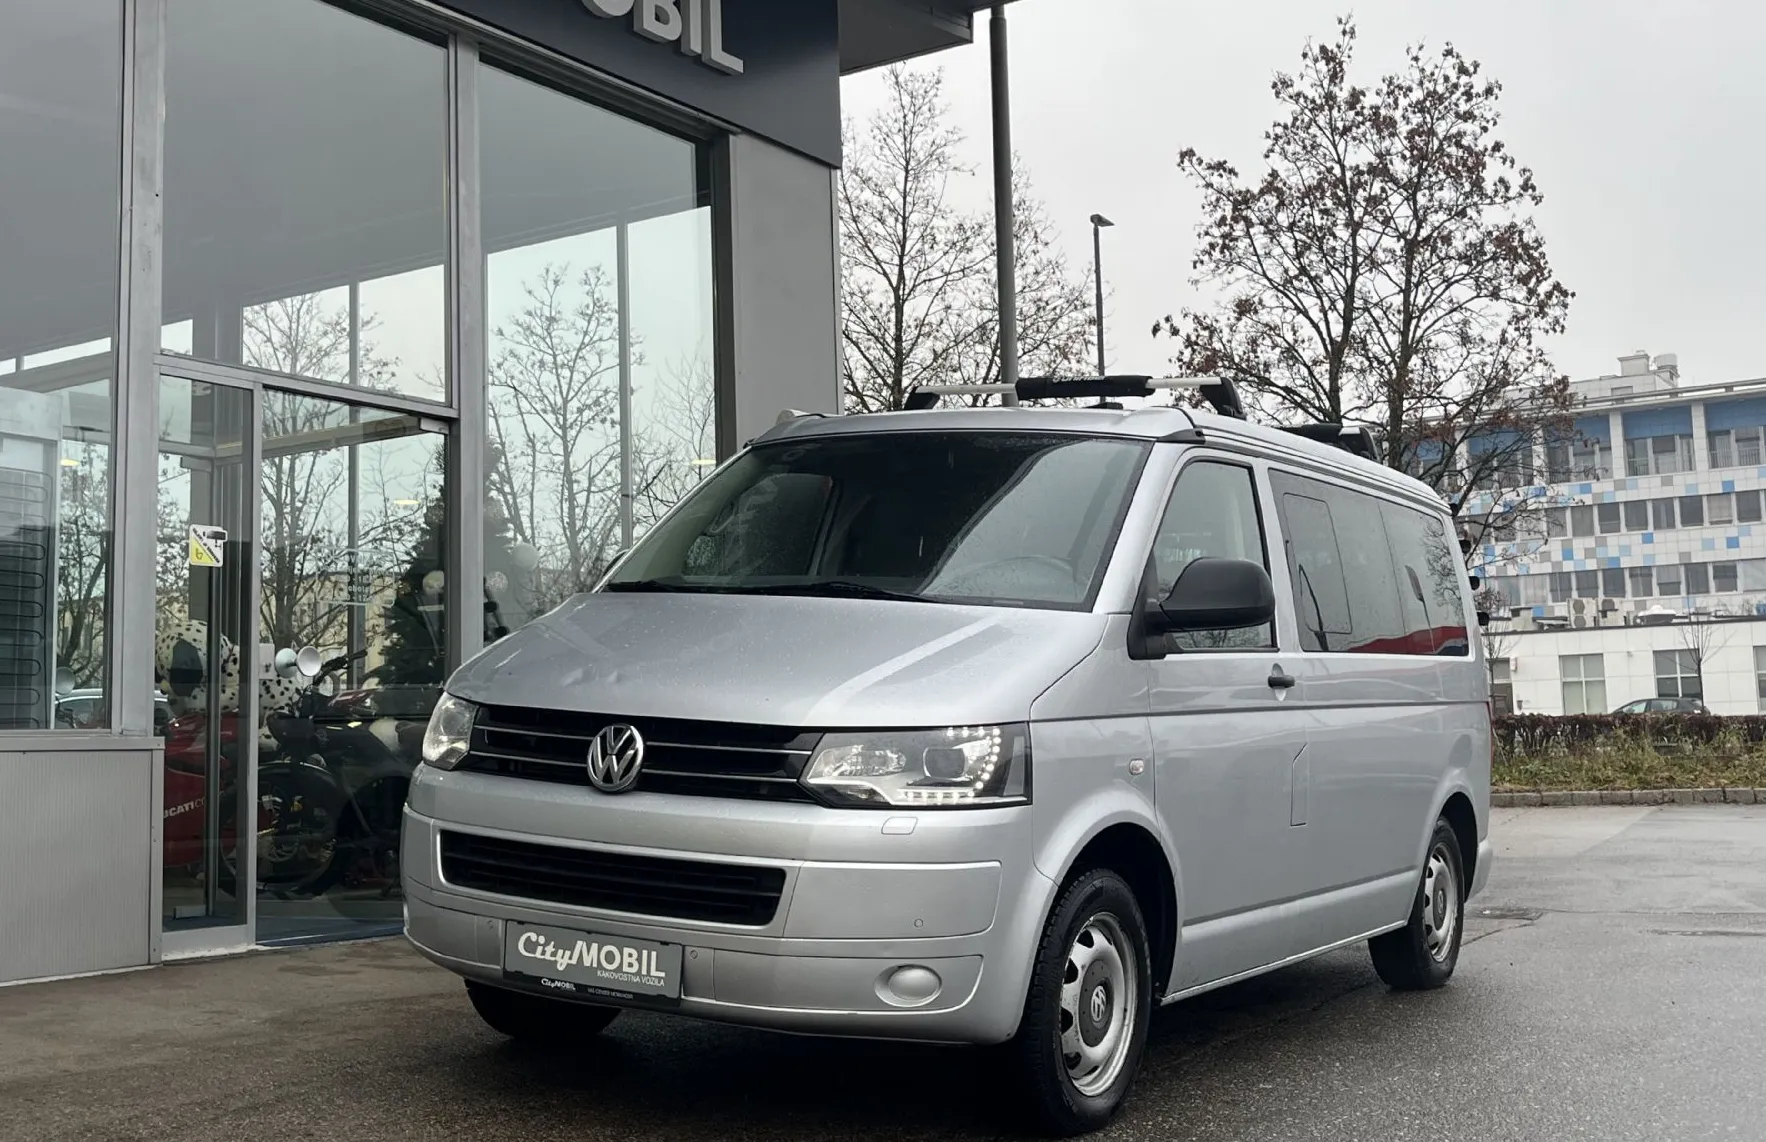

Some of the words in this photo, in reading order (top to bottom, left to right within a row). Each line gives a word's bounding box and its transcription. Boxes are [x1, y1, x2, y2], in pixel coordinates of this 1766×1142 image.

[582, 0, 744, 75] BIL
[518, 932, 665, 977] CityMOBIL
[597, 970, 641, 984] KAKOVOSTNA
[641, 976, 665, 987] VOZILA
